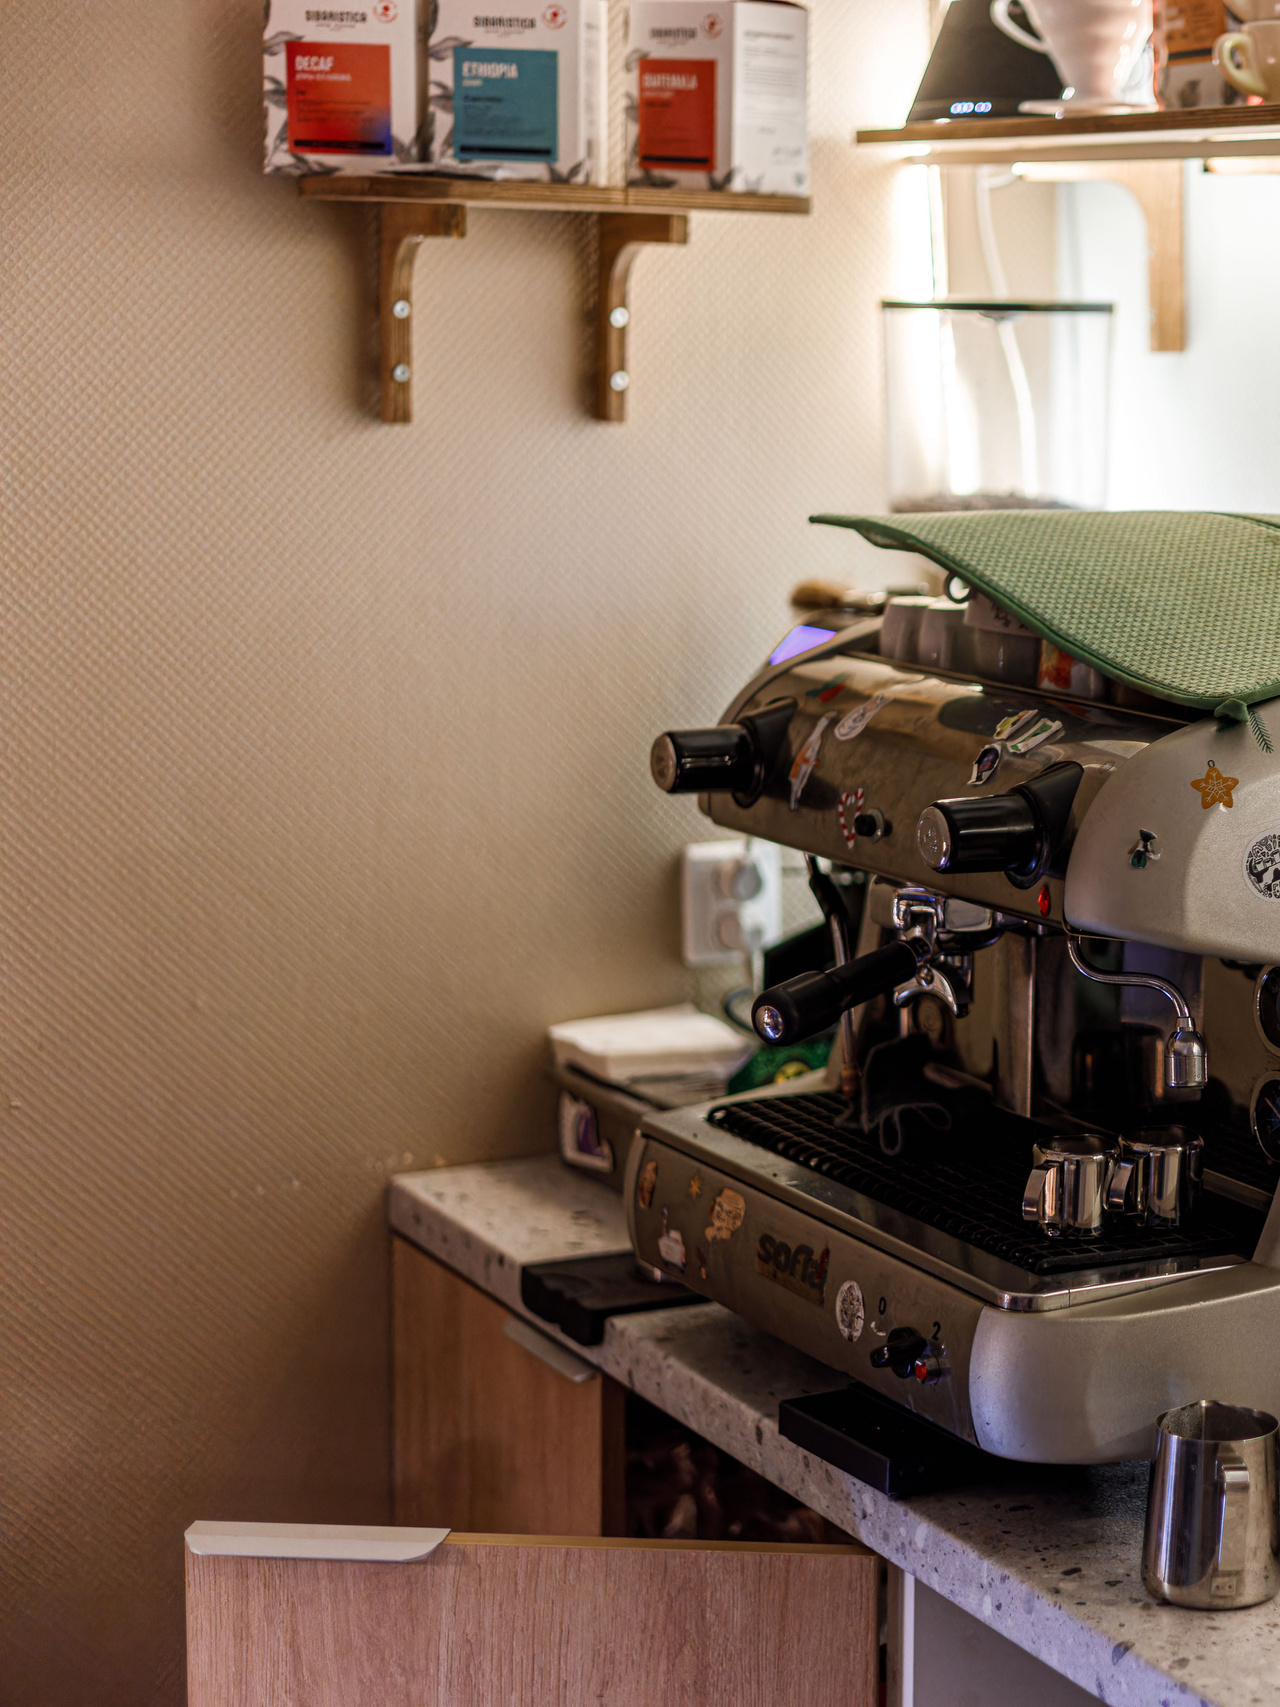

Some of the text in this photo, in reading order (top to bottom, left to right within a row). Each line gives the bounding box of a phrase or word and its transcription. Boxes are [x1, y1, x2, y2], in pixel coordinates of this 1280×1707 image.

[305, 10, 367, 24] SIBARISTICA
[473, 15, 536, 28] SIBARISTICA
[295, 55, 334, 71] DECAF
[462, 61, 519, 79] ETHIOPIA
[931, 1321, 942, 1341] 2
